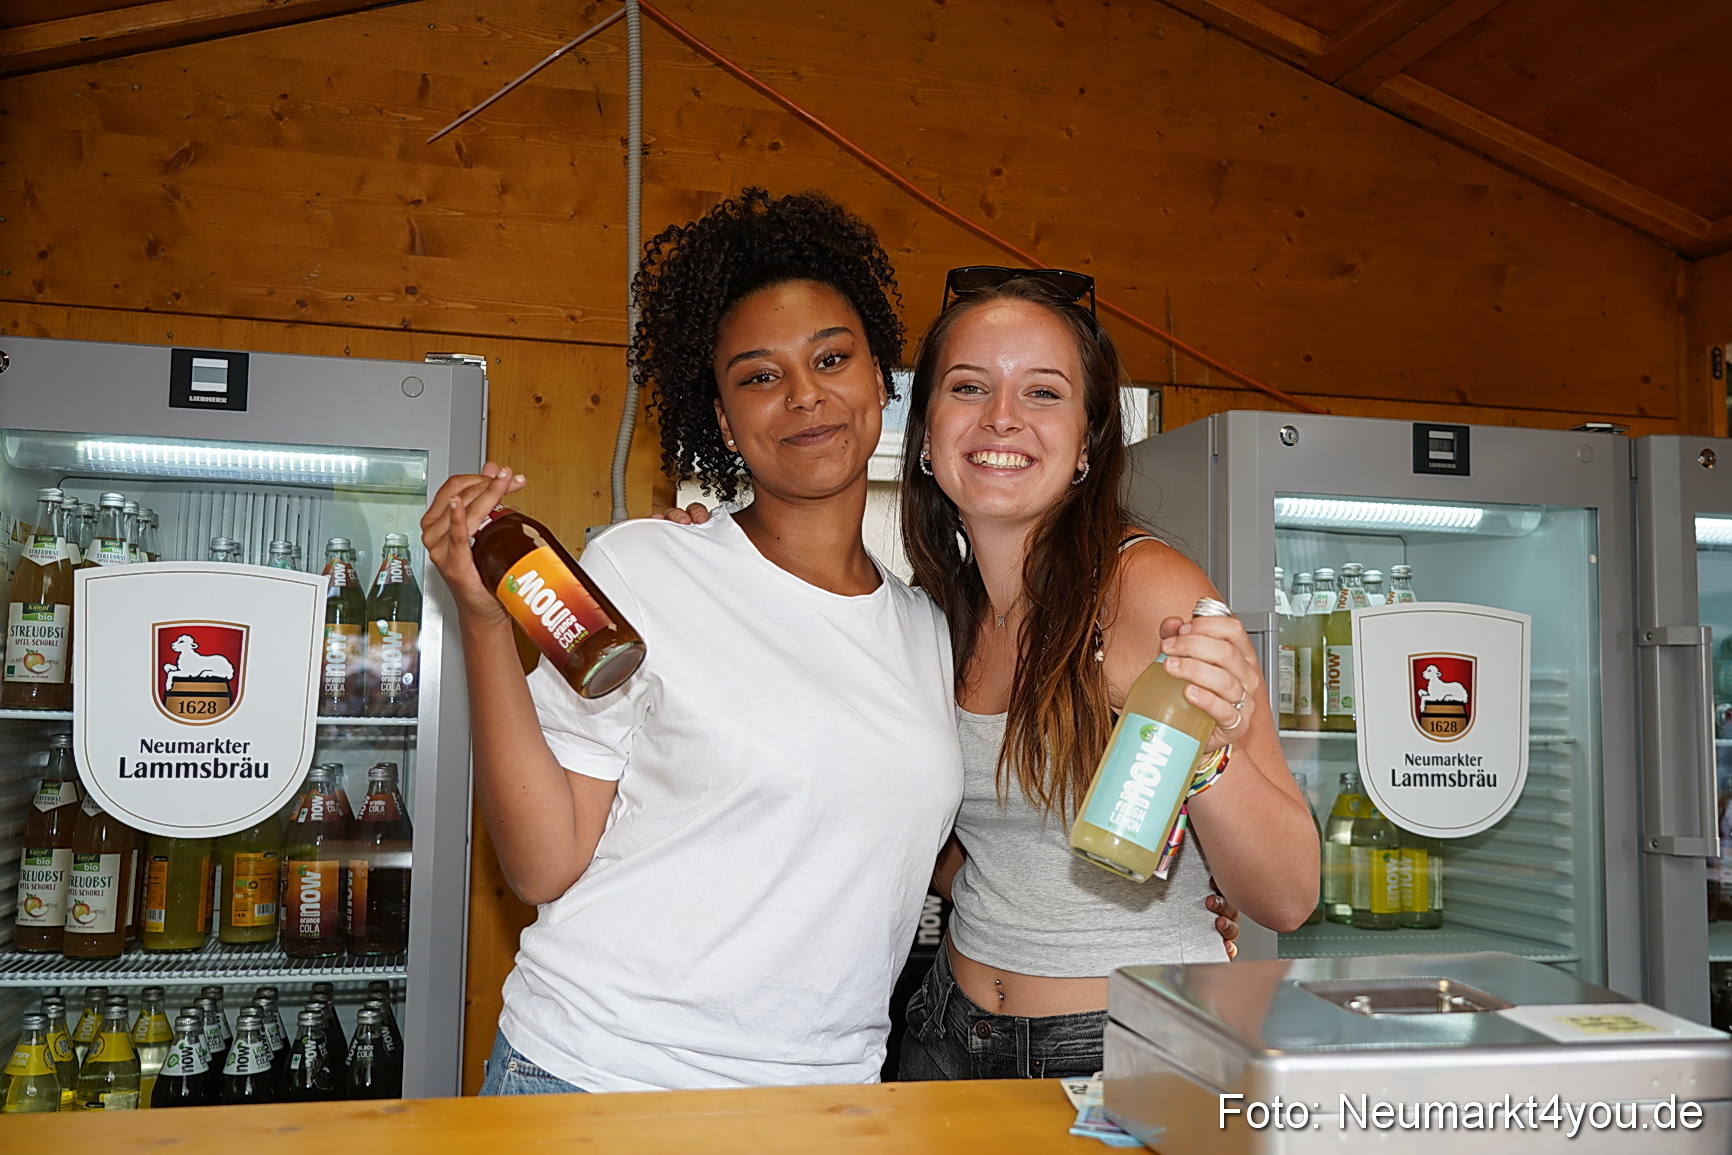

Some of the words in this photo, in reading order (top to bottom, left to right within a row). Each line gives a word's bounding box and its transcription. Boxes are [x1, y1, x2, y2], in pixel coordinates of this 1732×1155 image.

[188, 395, 228, 404] LIEBHERR
[334, 563, 347, 587] now
[390, 559, 404, 584] now
[517, 569, 571, 633] now
[1337, 588, 1349, 609] now
[37, 612, 53, 620] bio
[10, 625, 65, 639] STREUOBST
[558, 622, 586, 649] COLA
[325, 632, 347, 677] now
[381, 631, 403, 676] now
[1328, 653, 1341, 691] now
[324, 683, 346, 692] COLA
[380, 683, 402, 692] COLA
[178, 700, 217, 715] 1628
[1429, 720, 1458, 733] 1628
[140, 738, 250, 754] Neumarkter
[119, 757, 269, 779] Lammsbräu
[1404, 753, 1483, 767] Neumarkter
[1119, 735, 1173, 810] now
[1391, 769, 1497, 788] Lammsbräu
[310, 795, 324, 821] now
[368, 805, 386, 813] COLA
[36, 858, 51, 866] bio
[83, 863, 99, 871] bio
[20, 869, 65, 882] TREUOBST
[69, 875, 114, 888] TREUOBST
[1386, 857, 1399, 895] now
[299, 870, 322, 918] now
[299, 924, 321, 933] COLA
[918, 894, 942, 945] now
[80, 1015, 96, 1040] now
[136, 1015, 151, 1041] now
[207, 1038, 222, 1047] COLA
[381, 1026, 395, 1052] now
[14, 1051, 31, 1059] pure
[182, 1046, 195, 1074] now
[236, 1046, 250, 1074] now
[256, 1056, 270, 1066] COLA
[356, 1050, 374, 1058] COLA
